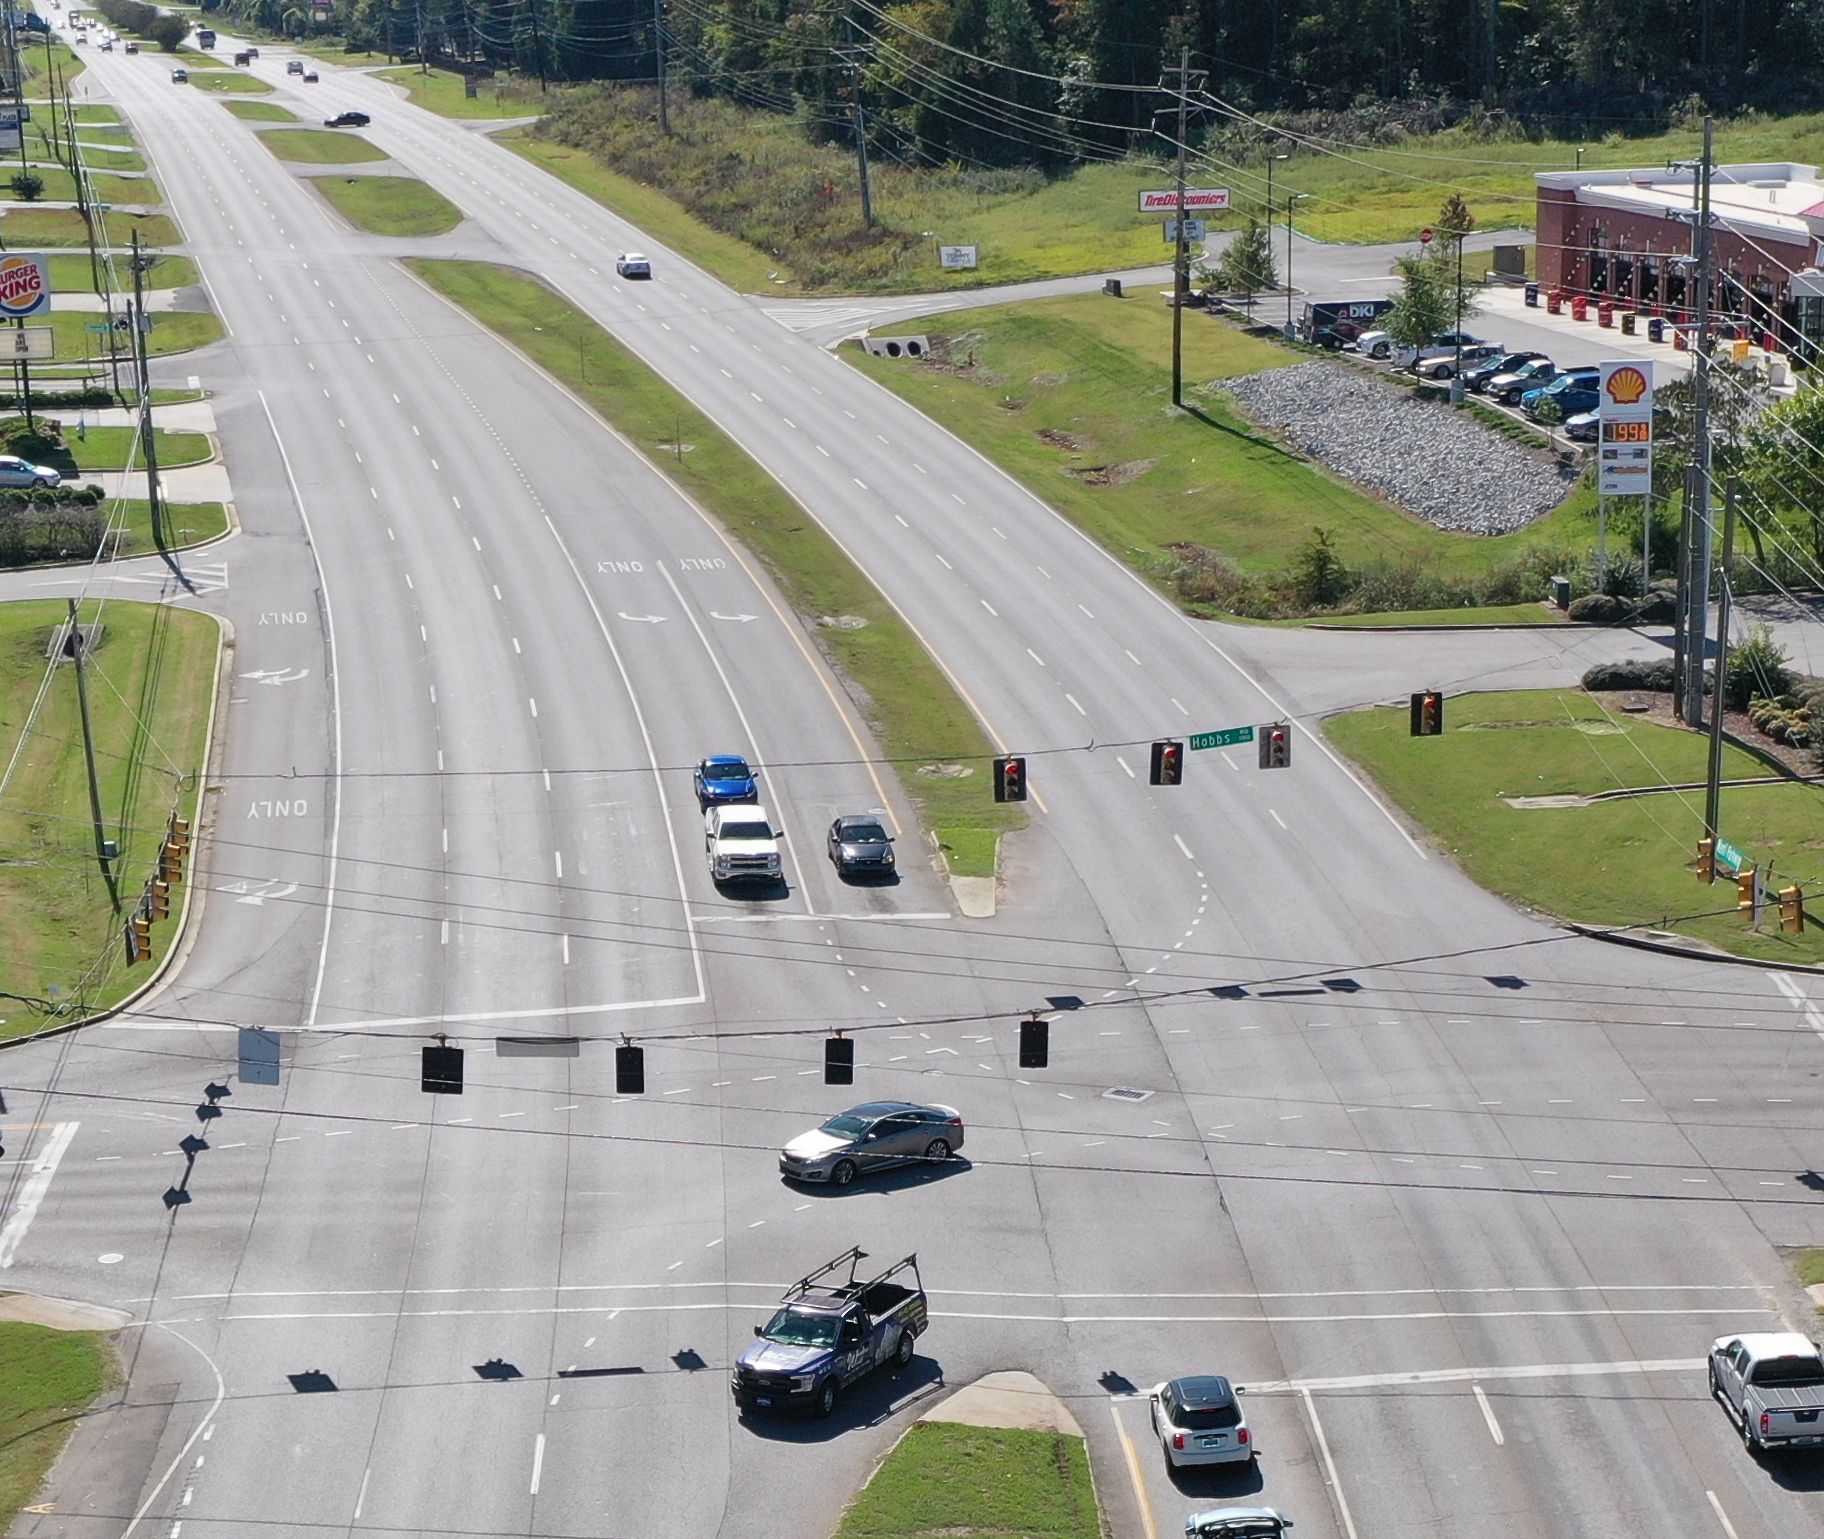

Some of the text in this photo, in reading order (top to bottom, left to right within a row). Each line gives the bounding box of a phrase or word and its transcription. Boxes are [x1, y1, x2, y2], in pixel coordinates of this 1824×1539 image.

[596, 560, 644, 574] ONLY
[679, 558, 726, 571] ONLY
[257, 611, 308, 625] ONLY
[1192, 733, 1231, 749] Hobbs
[247, 799, 308, 820] ONLY
